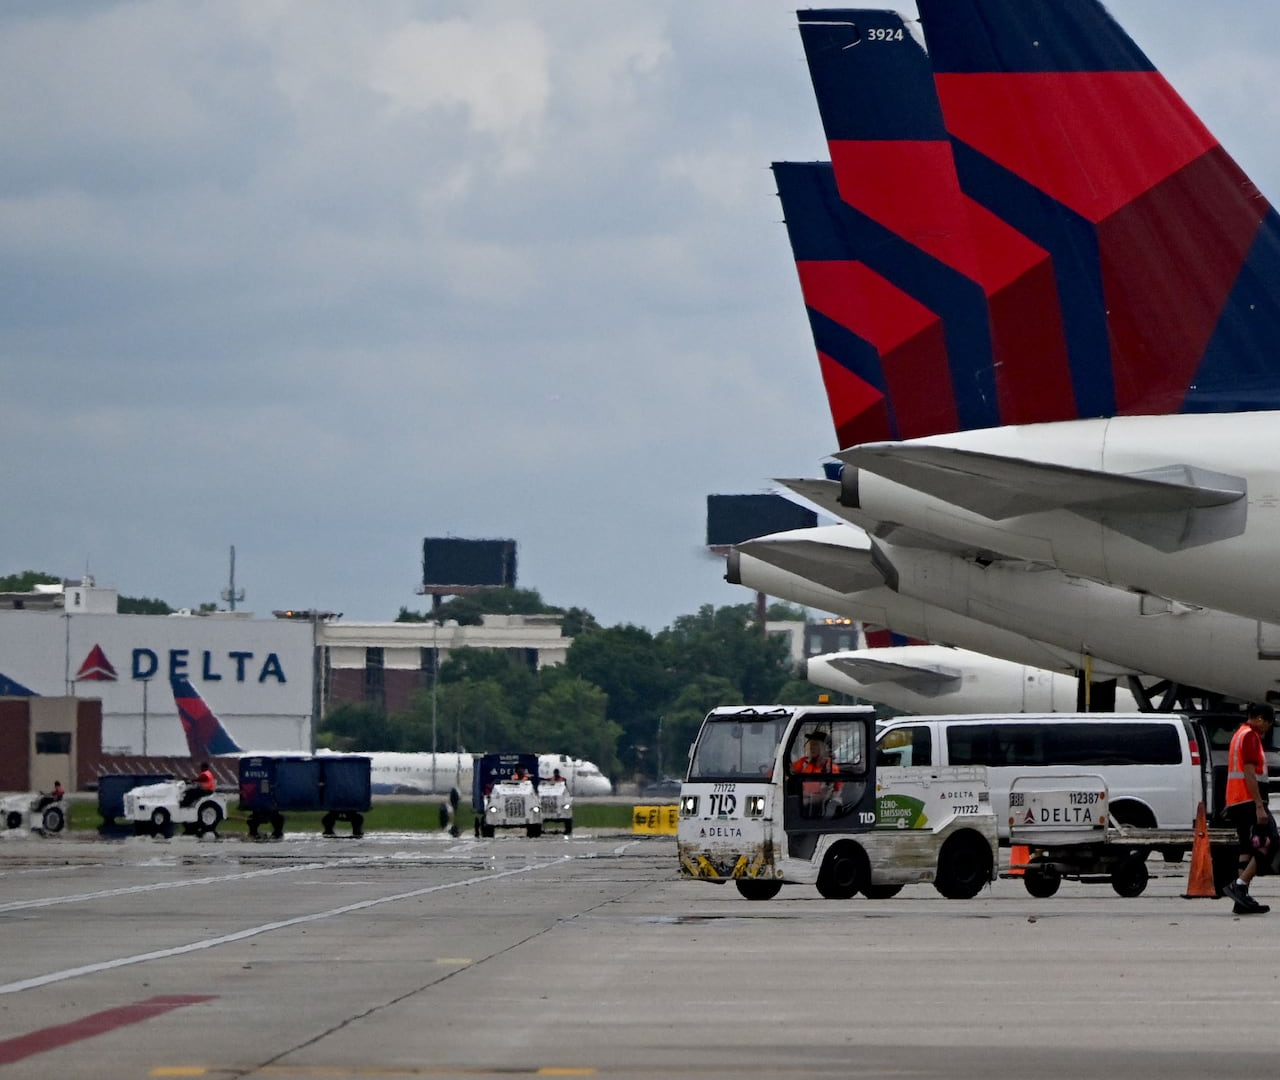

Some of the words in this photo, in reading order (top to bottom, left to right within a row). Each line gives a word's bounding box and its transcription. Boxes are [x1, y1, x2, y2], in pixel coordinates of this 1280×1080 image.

[867, 28, 904, 41] 3924
[131, 647, 287, 683] DELTA
[714, 783, 736, 793] 771722
[709, 794, 737, 816] TLD
[880, 800, 897, 809] ZERO-
[1069, 793, 1099, 805] 112387
[880, 808, 912, 818] EMISSIONS
[952, 805, 979, 815] 771722
[1041, 807, 1092, 822] DELTA
[859, 812, 876, 824] TLD
[709, 828, 742, 837] DELTA
